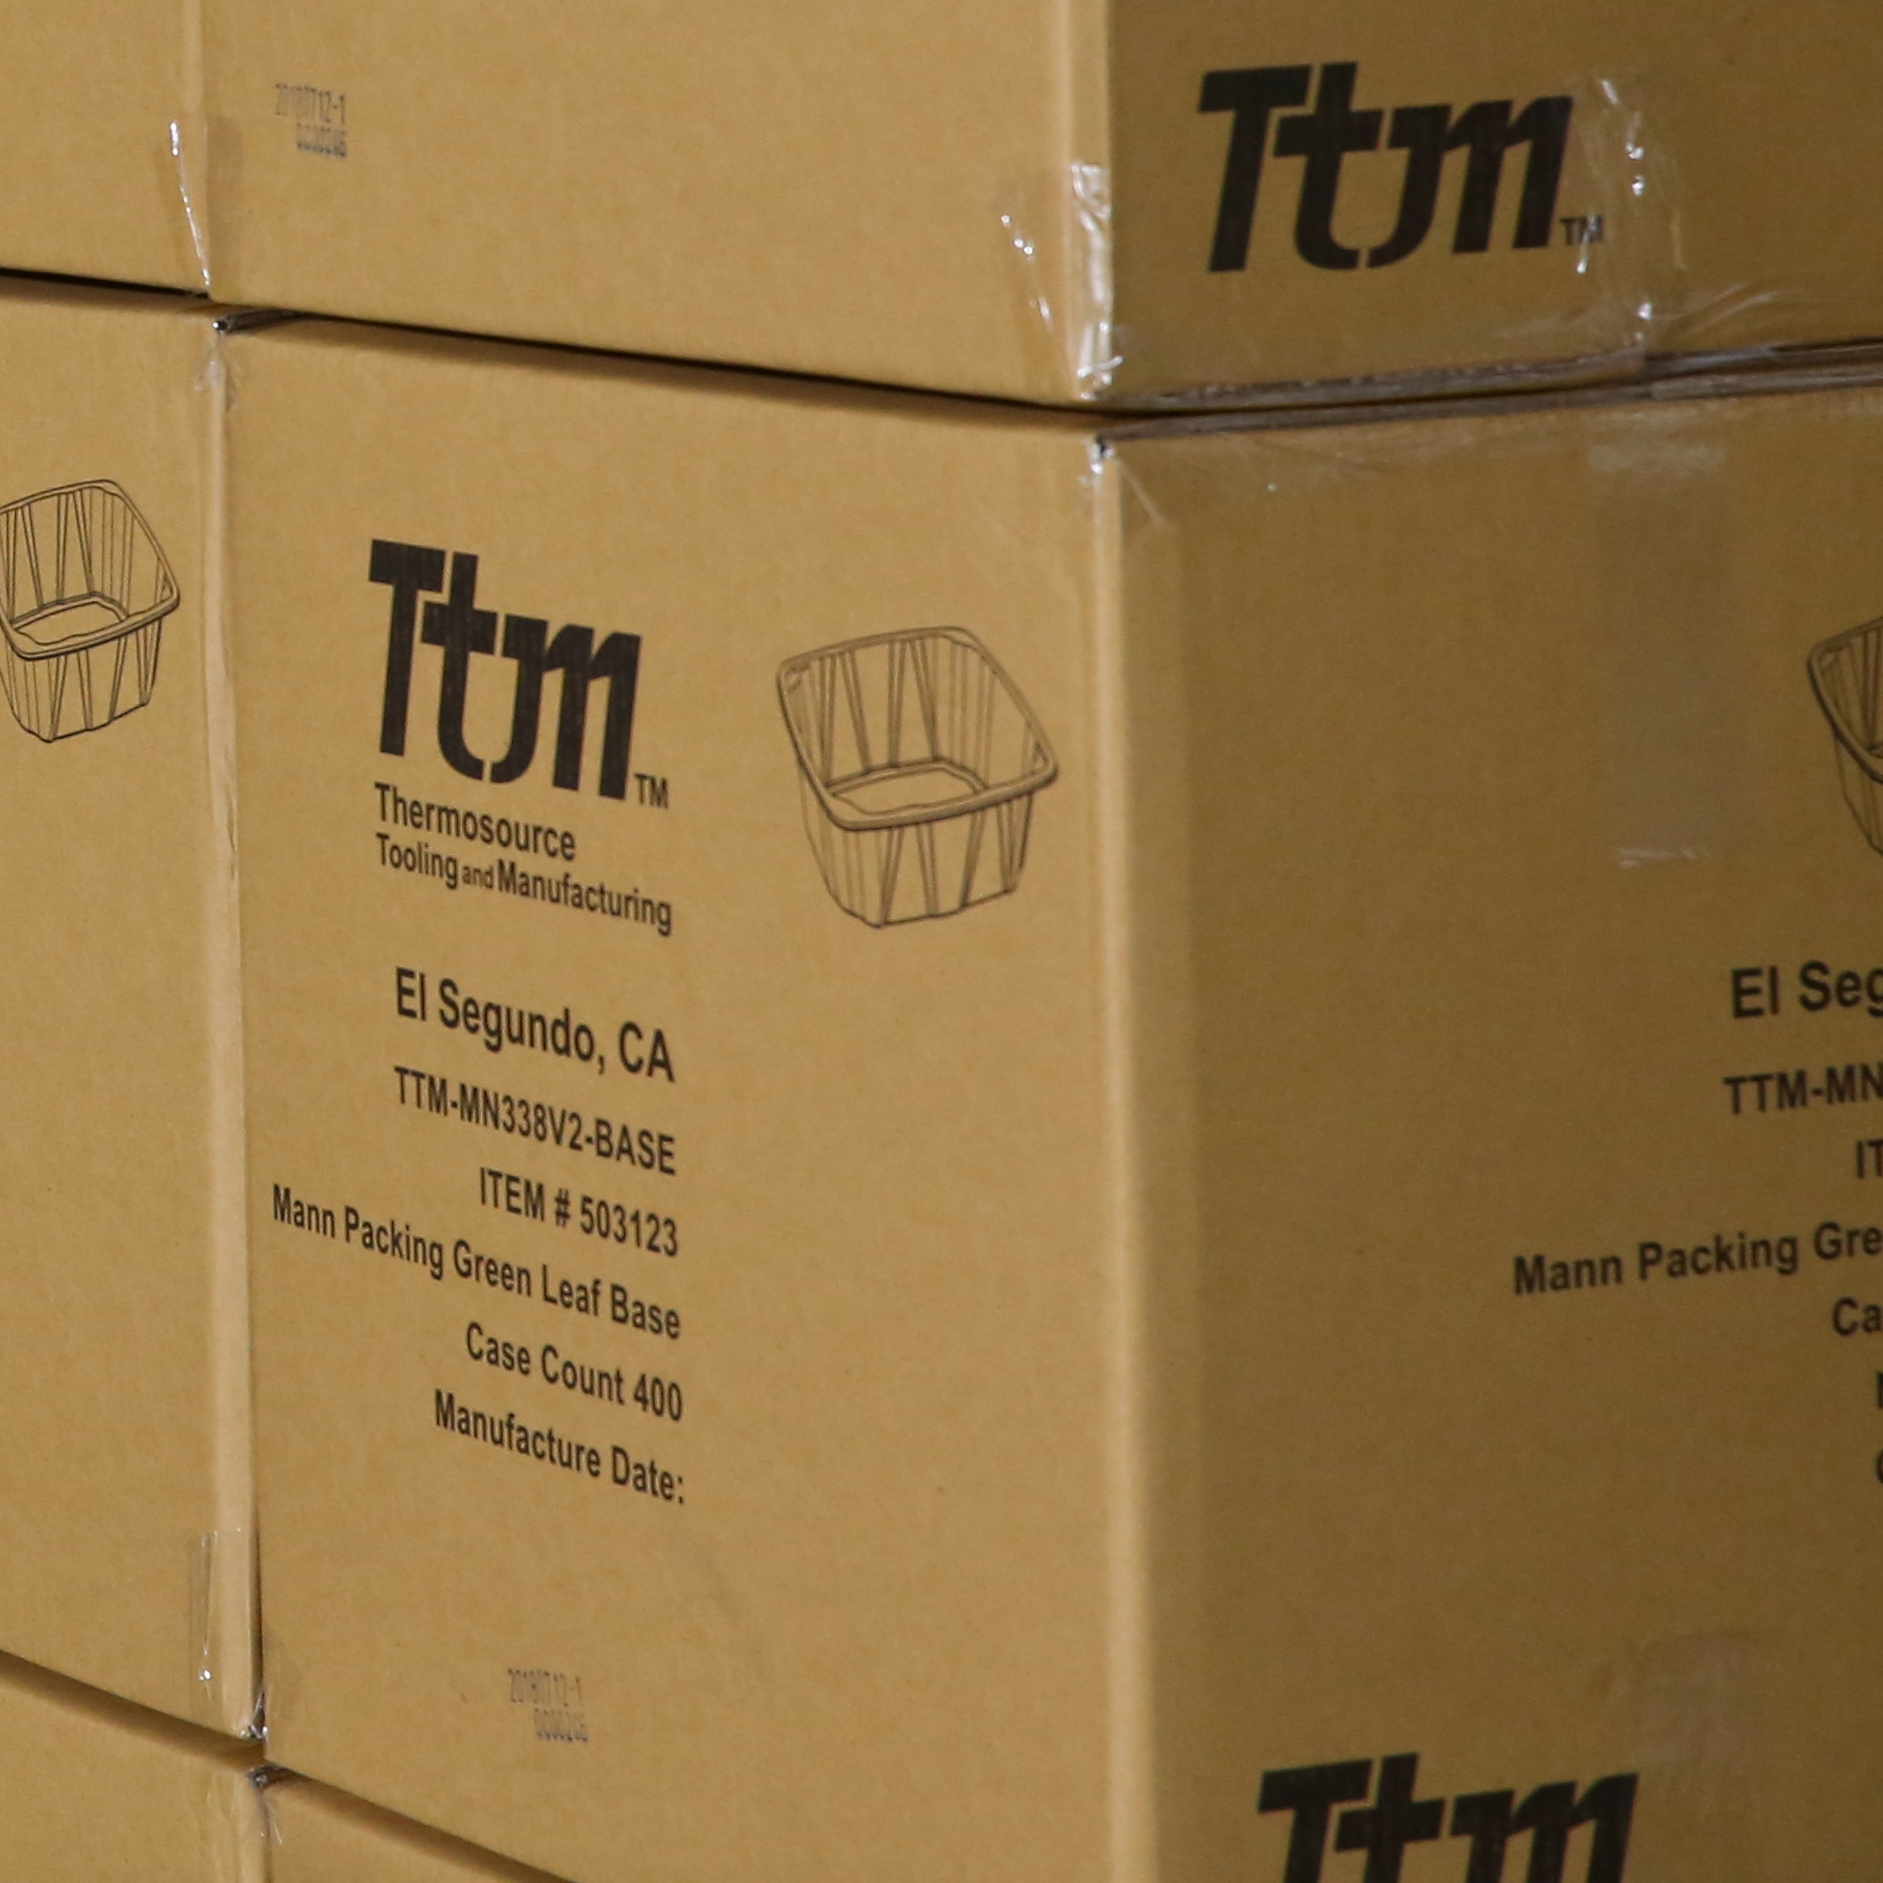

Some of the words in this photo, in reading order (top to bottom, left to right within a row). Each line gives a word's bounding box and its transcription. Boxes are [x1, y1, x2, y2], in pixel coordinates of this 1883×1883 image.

[374, 781, 576, 862] Thermosource
[375, 832, 459, 891] Tooling
[462, 865, 494, 890] and
[497, 858, 672, 938] Manufacturing
[396, 966, 427, 1022] El
[438, 978, 605, 1075] Segundo,
[618, 1021, 675, 1083] CA
[1731, 965, 1779, 1019] El
[393, 1065, 676, 1176] TTM-MN338V2-BASE
[273, 1183, 336, 1239] Mann
[344, 1205, 444, 1281] Packing
[453, 1239, 532, 1298] Green
[542, 1264, 601, 1317] Leaf
[610, 1283, 680, 1340] Base
[480, 1167, 545, 1222] ITEM
[554, 1188, 571, 1228] #
[580, 1195, 678, 1258] 503123
[1514, 1254, 1623, 1295] Mann
[1638, 1231, 1799, 1281] Packing
[466, 1321, 531, 1376] Case
[541, 1344, 624, 1406] Count
[633, 1373, 683, 1422] 400
[434, 1388, 601, 1478] Manufacture
[611, 1445, 684, 1505] Date:
